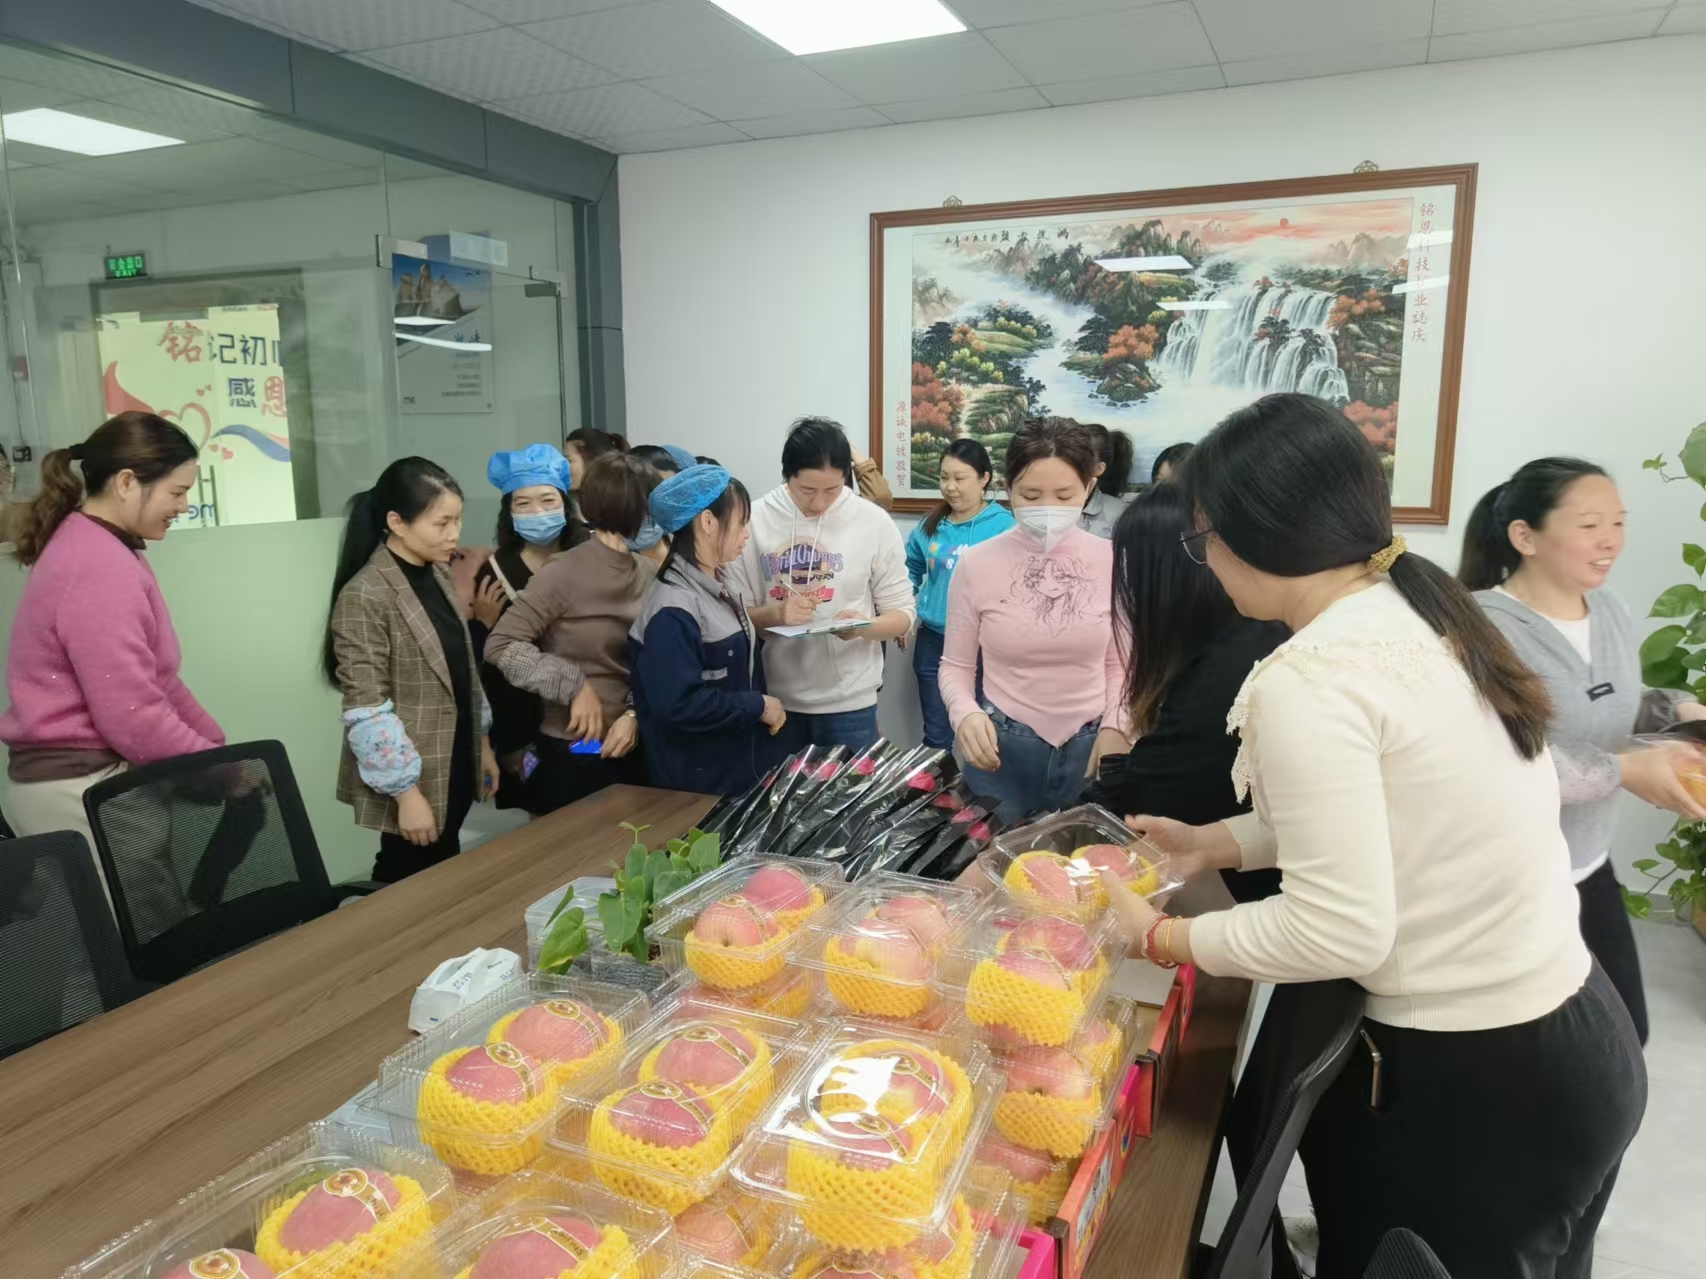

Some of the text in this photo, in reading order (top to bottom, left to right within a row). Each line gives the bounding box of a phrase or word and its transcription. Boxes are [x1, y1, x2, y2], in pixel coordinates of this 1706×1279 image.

[1411, 202, 1436, 342] 铭恩技业誌庆
